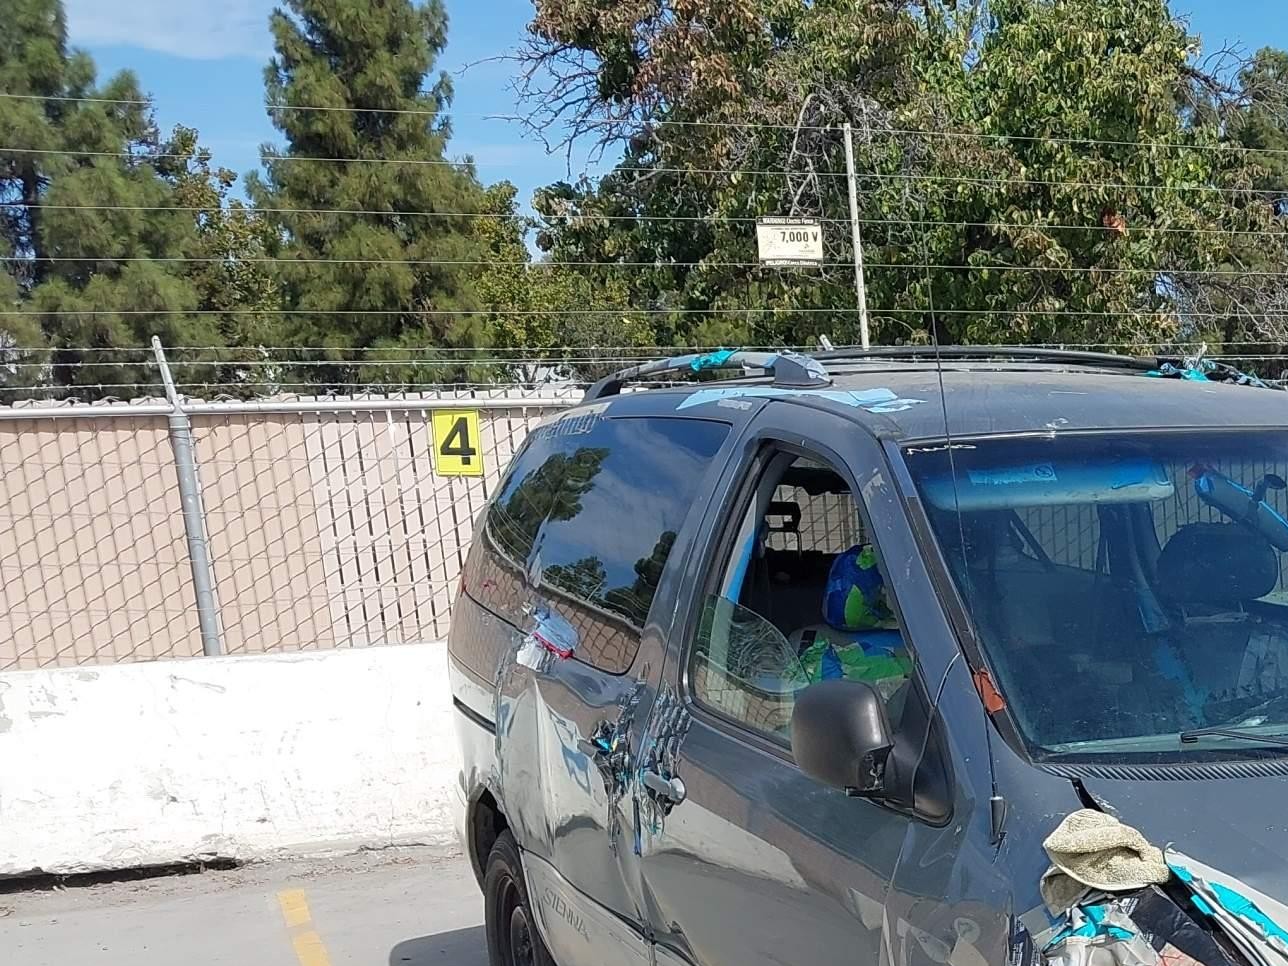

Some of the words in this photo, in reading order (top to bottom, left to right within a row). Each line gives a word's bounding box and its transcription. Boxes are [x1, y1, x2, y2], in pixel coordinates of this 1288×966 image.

[780, 231, 809, 244] 7,000
[811, 231, 818, 242] V
[439, 416, 477, 466] 4
[542, 887, 590, 943] SIENNA
